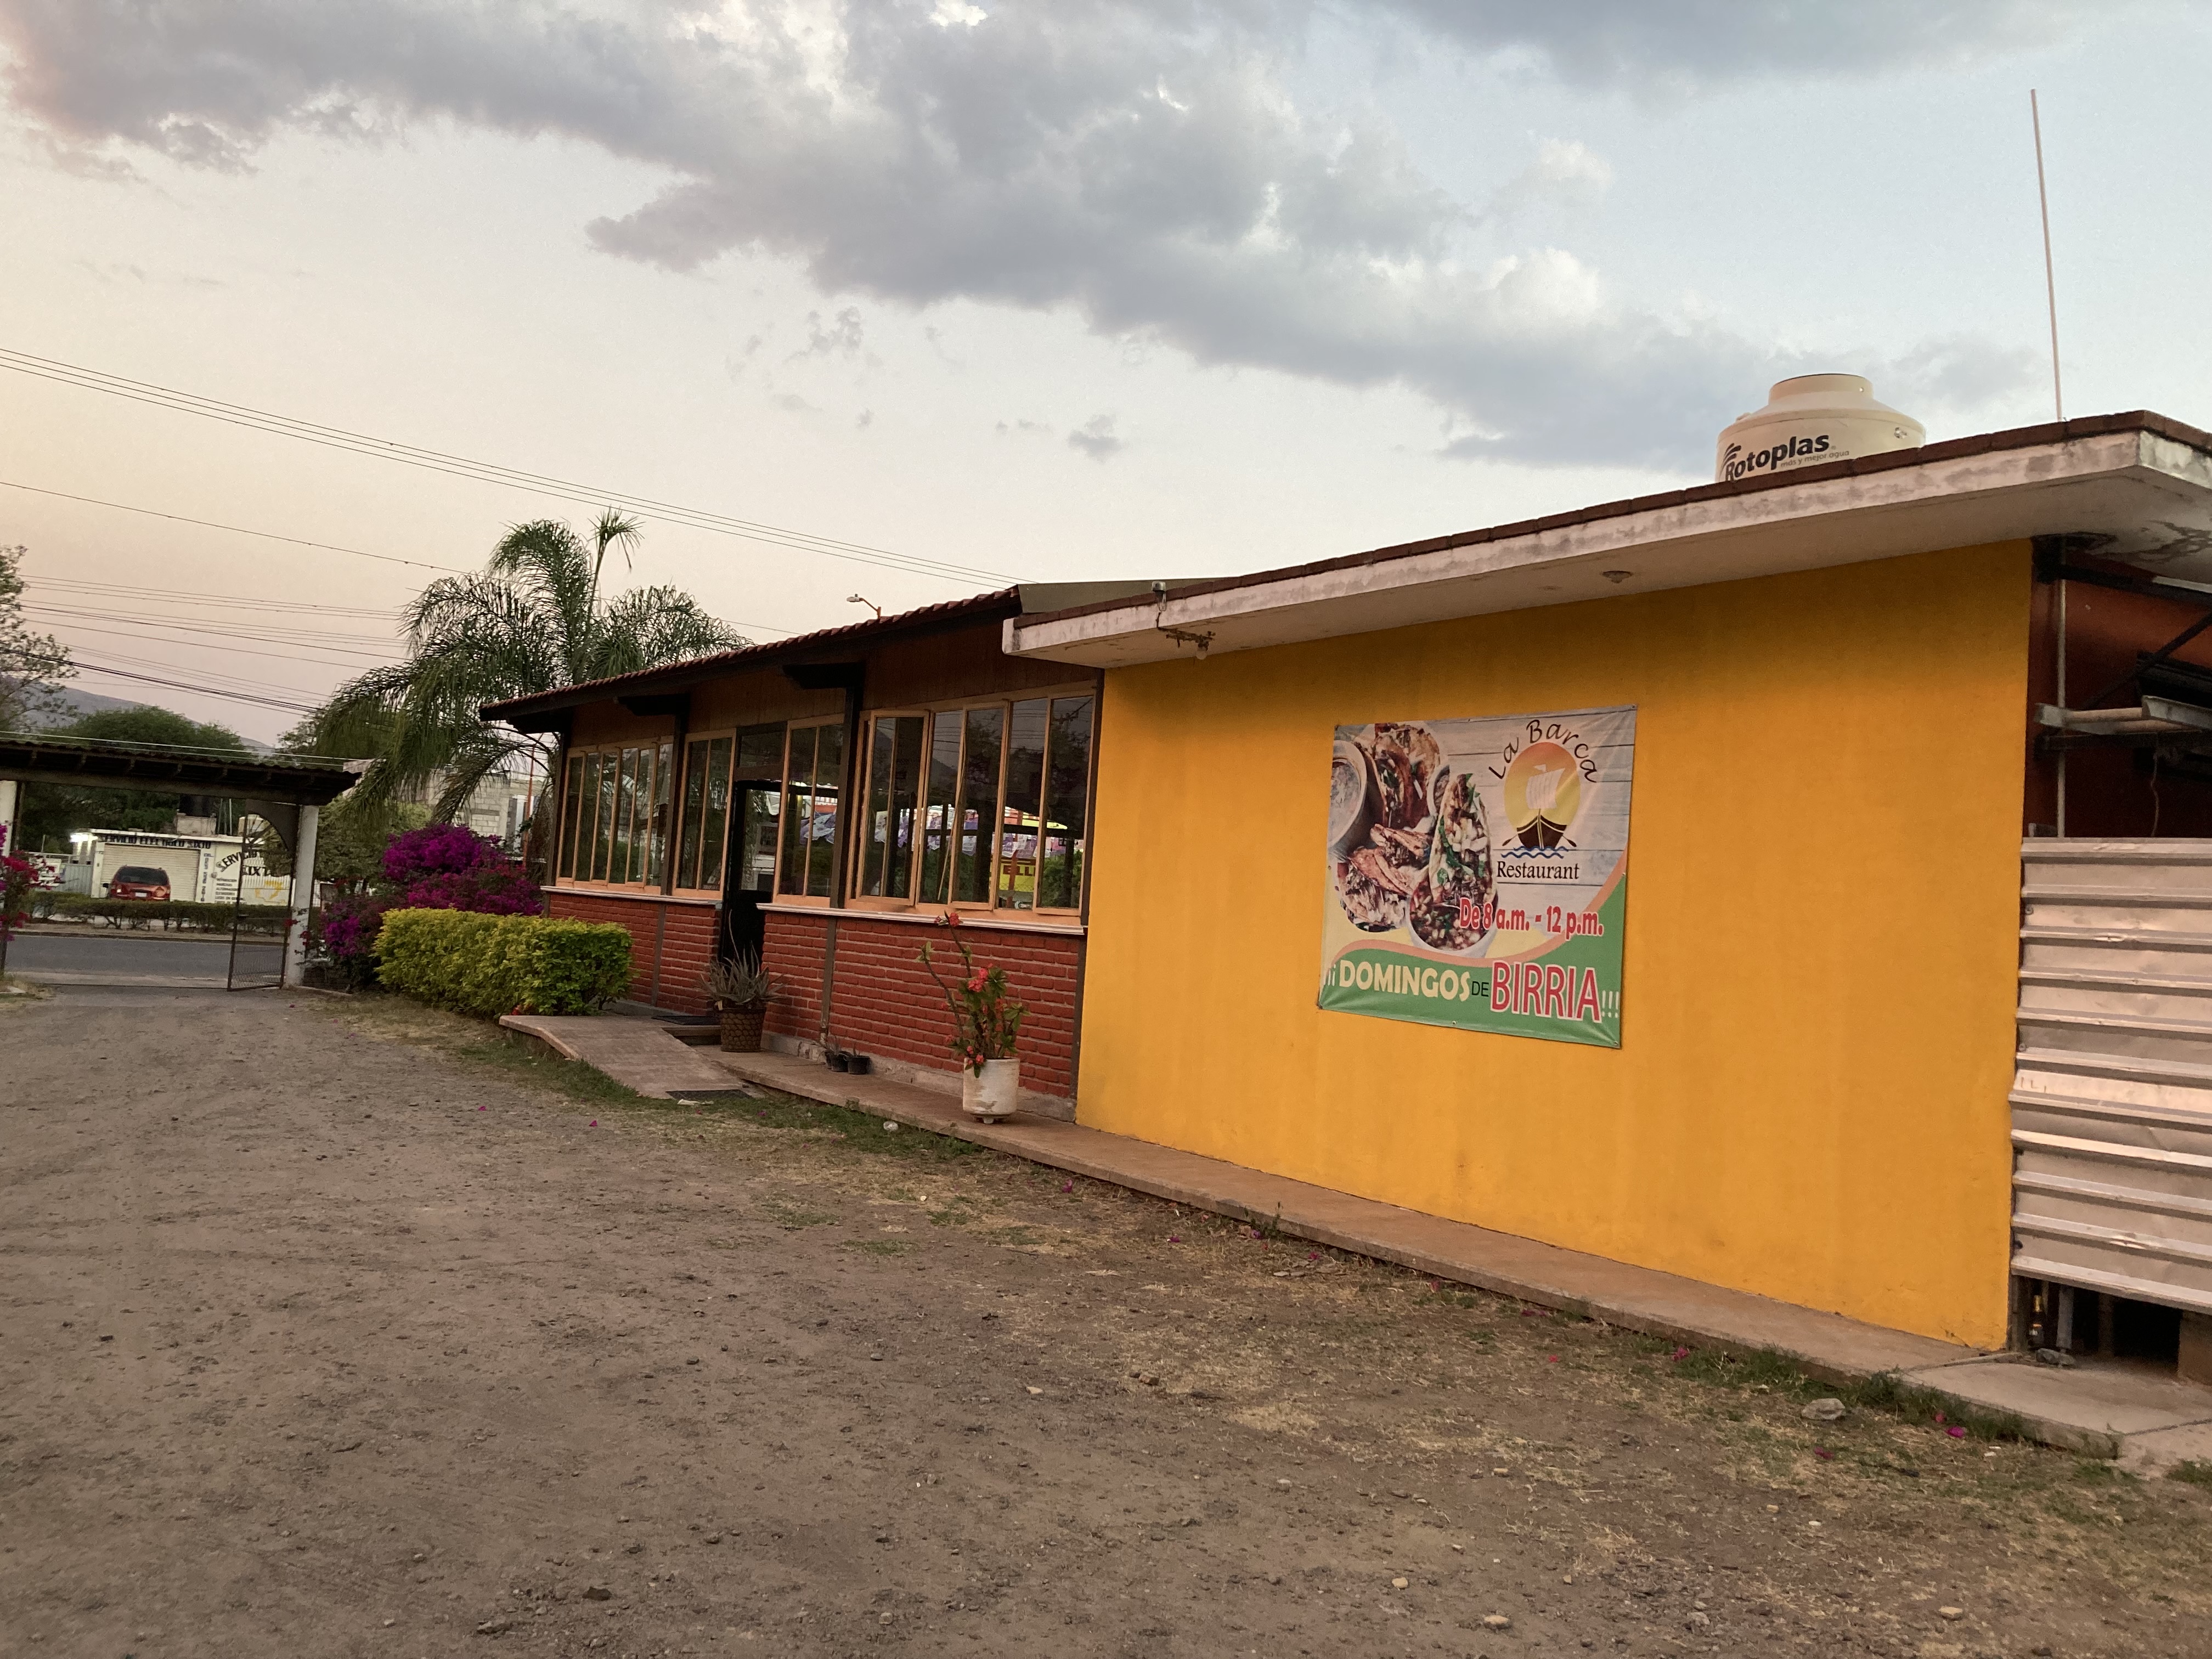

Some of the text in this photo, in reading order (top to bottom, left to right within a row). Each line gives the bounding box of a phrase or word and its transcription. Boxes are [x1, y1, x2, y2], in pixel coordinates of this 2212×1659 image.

[1725, 435, 1829, 482] Rotoplas
[1804, 453, 1827, 462] mejor
[1829, 450, 1850, 459] agua
[1488, 719, 1598, 783] La Barca
[1497, 861, 1579, 879] Restaurant
[1459, 897, 1481, 929] De
[1483, 902, 1493, 930] 8
[1496, 908, 1530, 931] a.m.
[1546, 905, 1562, 933] 12
[1565, 911, 1604, 941] p.m.
[1471, 980, 1489, 997] DE
